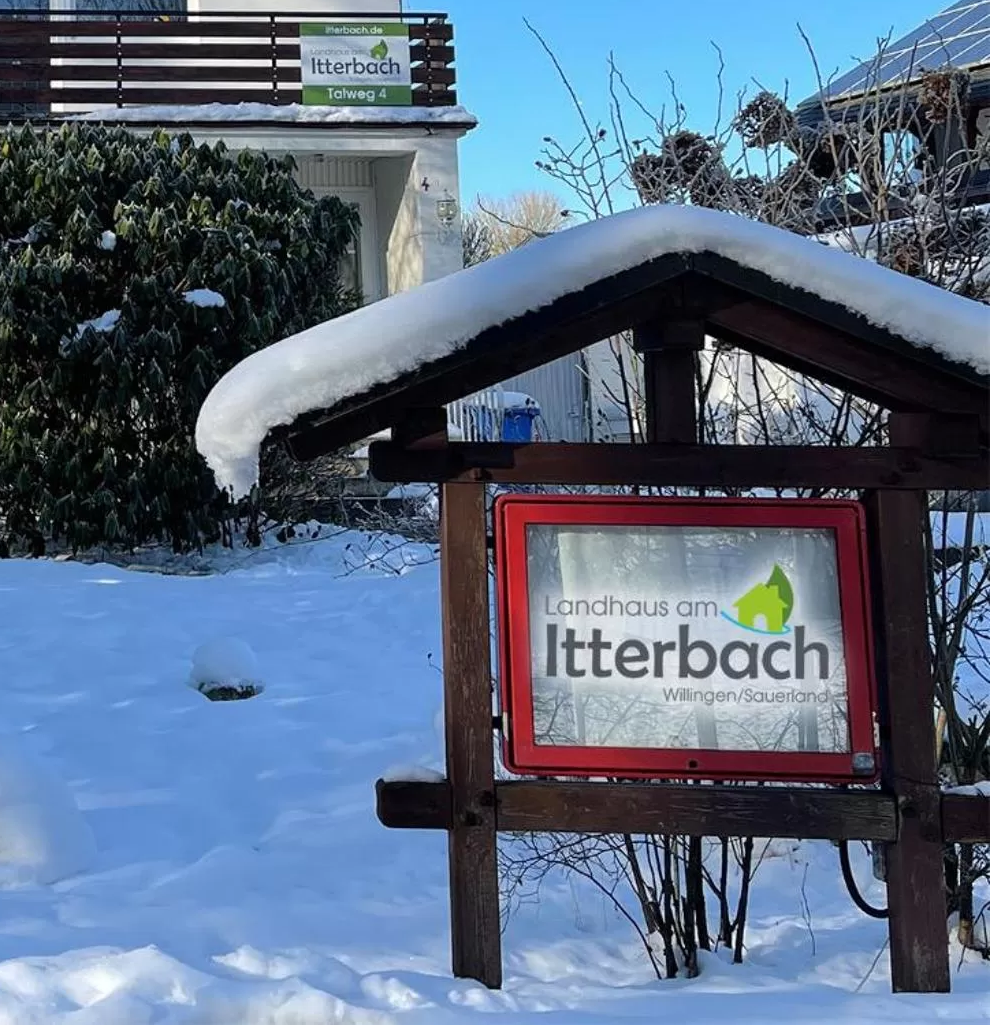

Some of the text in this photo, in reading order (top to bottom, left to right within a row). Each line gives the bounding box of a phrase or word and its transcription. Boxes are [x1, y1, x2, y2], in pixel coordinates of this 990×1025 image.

[311, 57, 400, 74] Itterbach
[328, 87, 387, 102] Talweg 4
[545, 595, 717, 617] Landhaus am
[546, 624, 829, 680] Itterbach
[663, 687, 829, 705] Willingen/Sauerland
